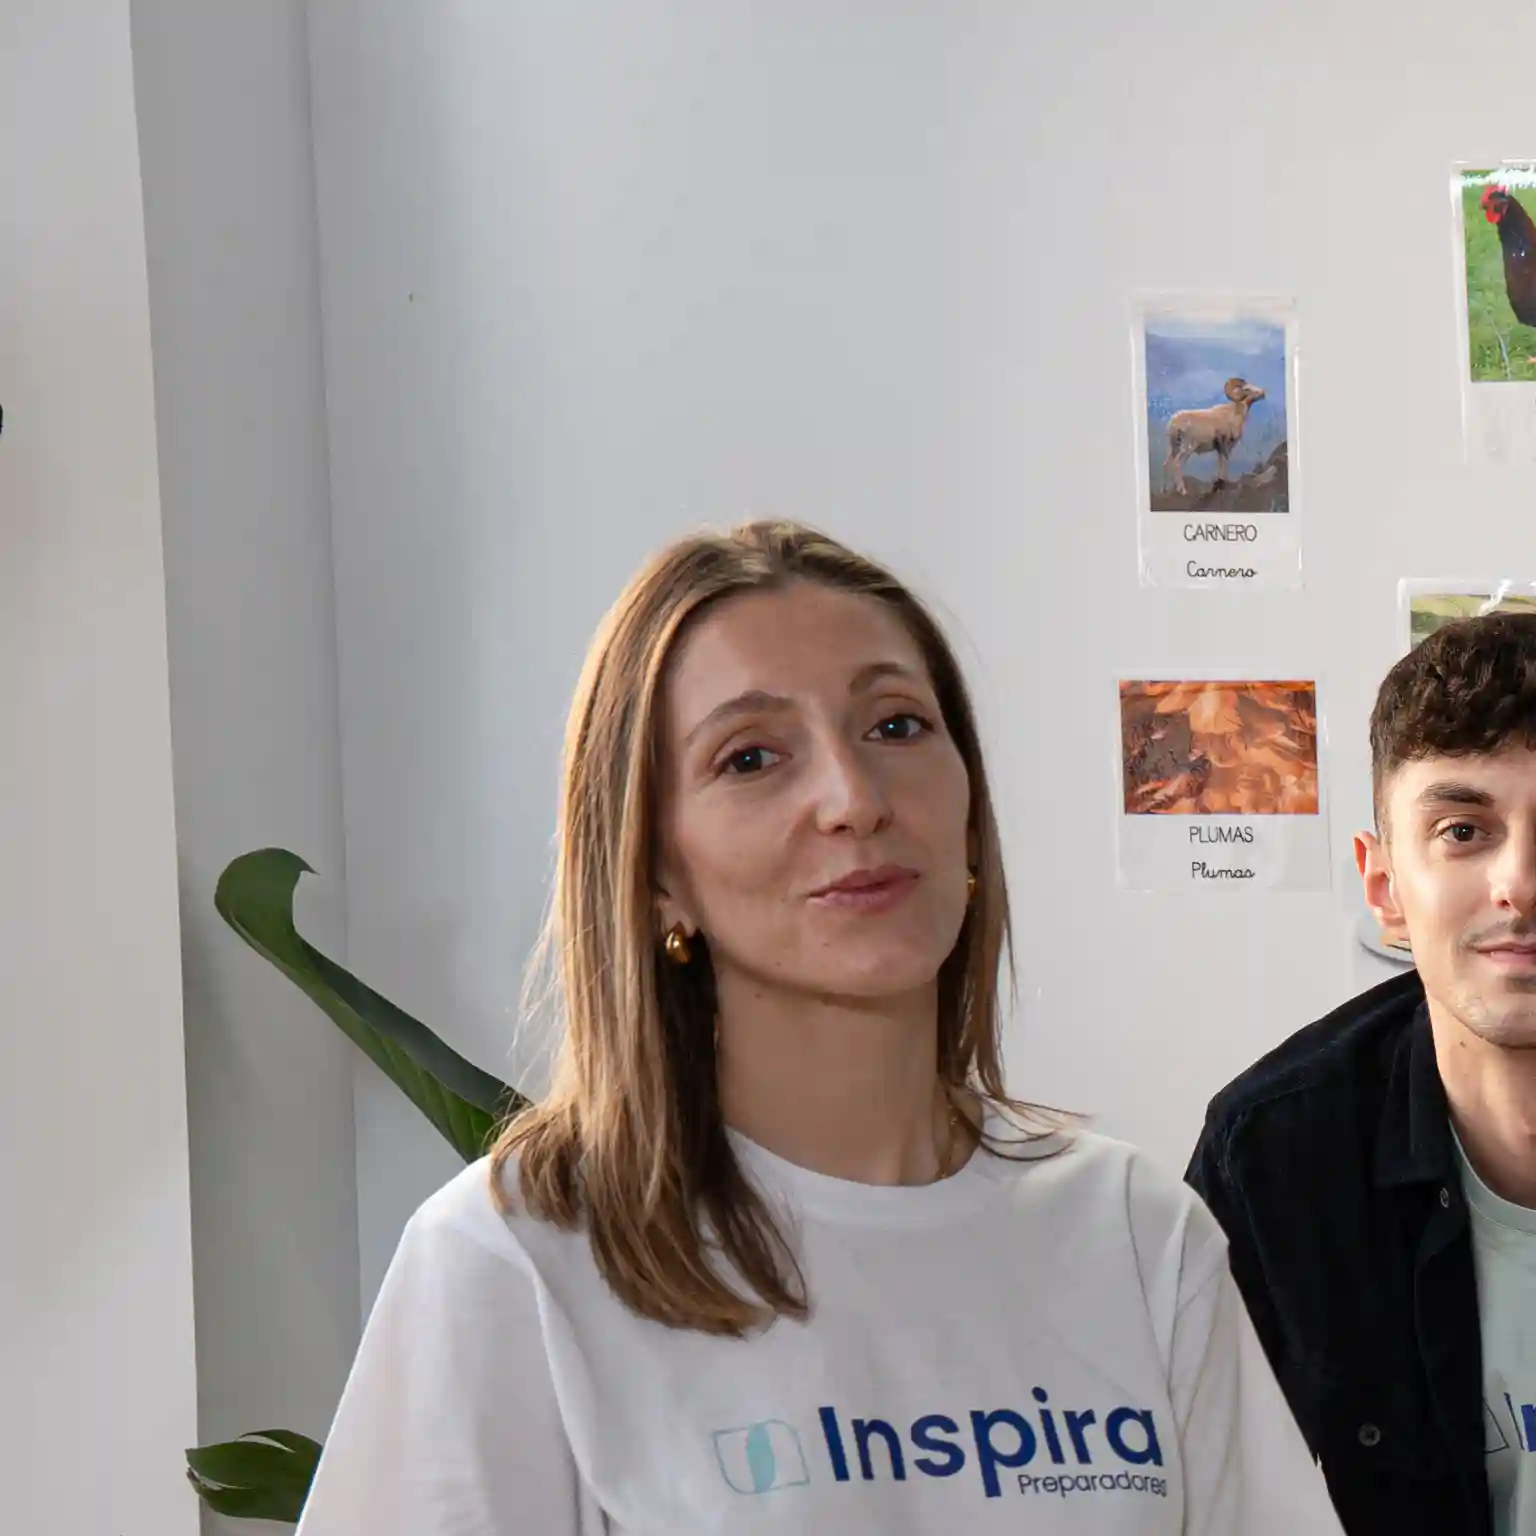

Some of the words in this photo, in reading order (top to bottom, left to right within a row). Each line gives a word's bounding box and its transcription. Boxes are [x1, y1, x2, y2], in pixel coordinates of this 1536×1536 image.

[1183, 523, 1258, 542] CARNERO
[1186, 559, 1259, 578] Carnero
[1188, 825, 1255, 844] PLUMAS
[1190, 861, 1256, 880] Plumas
[818, 1386, 1164, 1498] Inspira
[1018, 1470, 1168, 1500] Preparadores
